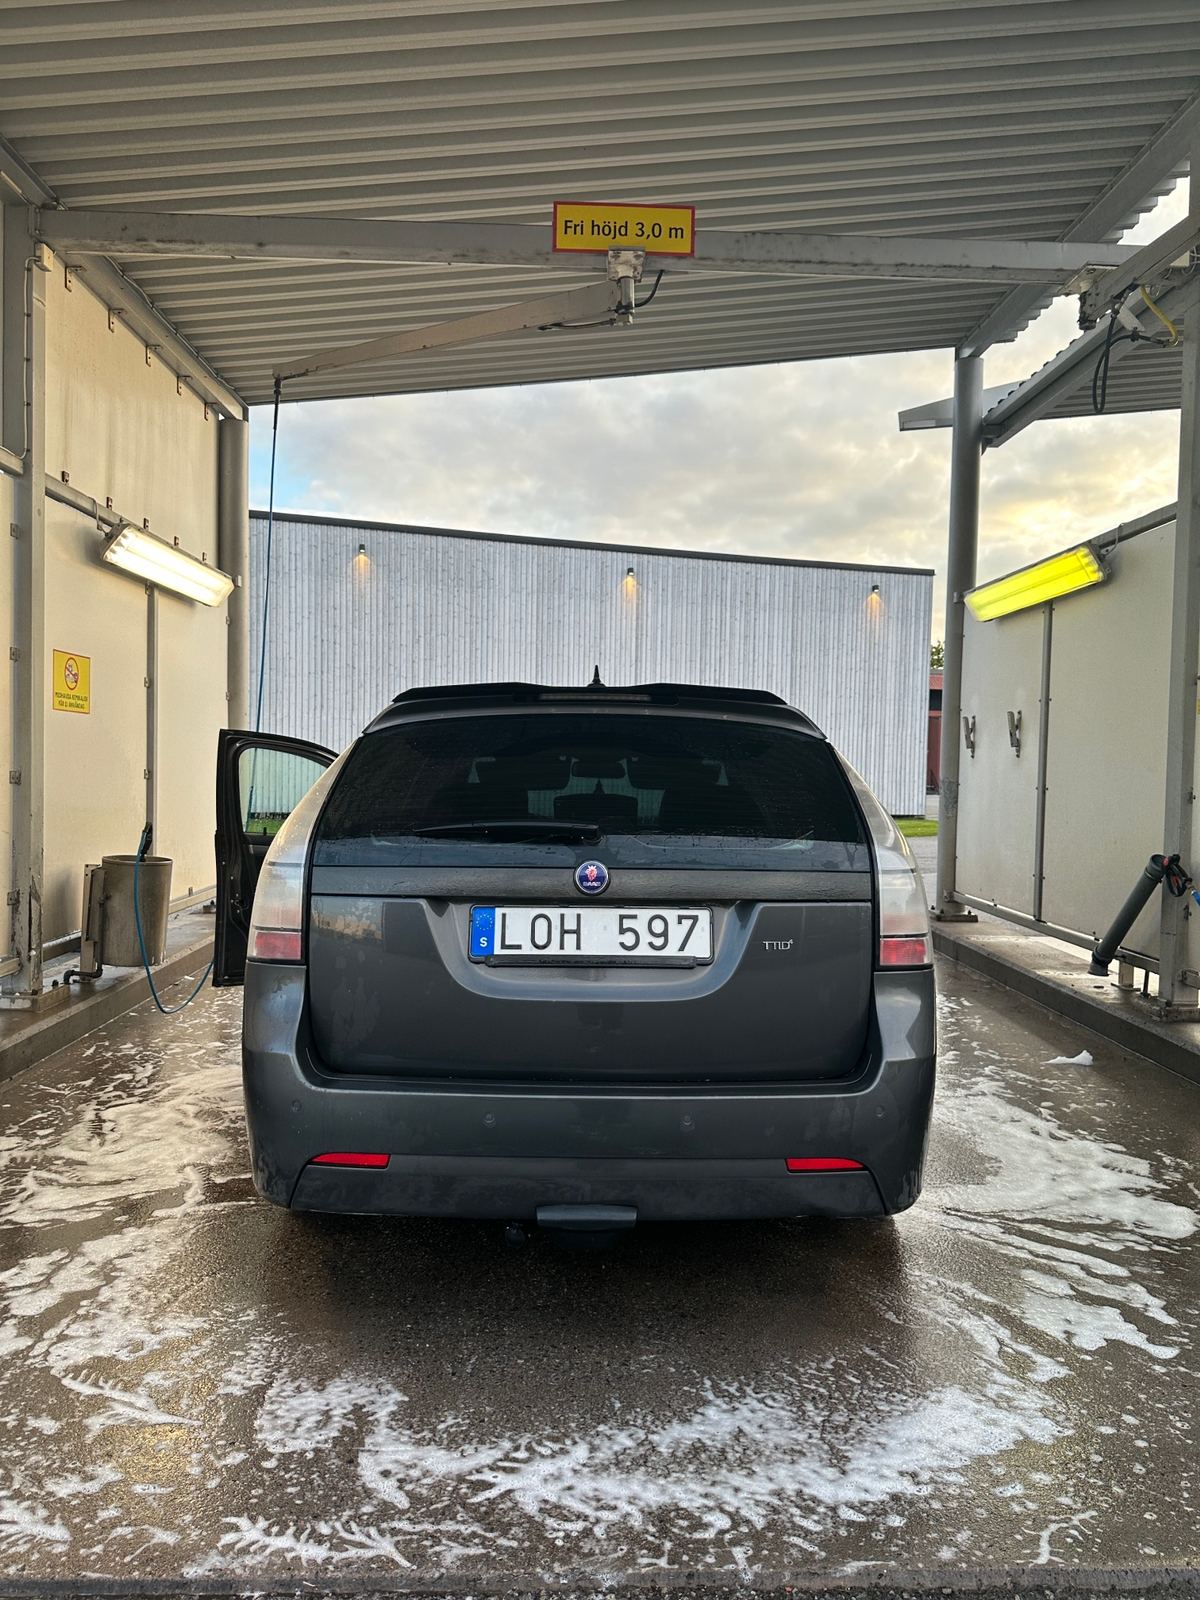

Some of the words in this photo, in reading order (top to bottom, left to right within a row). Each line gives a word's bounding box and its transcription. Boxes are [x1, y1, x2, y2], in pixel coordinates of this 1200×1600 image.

[563, 219, 584, 236] Fri
[591, 219, 628, 240] höjd
[634, 221, 662, 240] 3,0
[668, 226, 684, 239] m
[479, 936, 488, 948] S
[500, 912, 582, 951] LOH
[618, 914, 699, 952] 597
